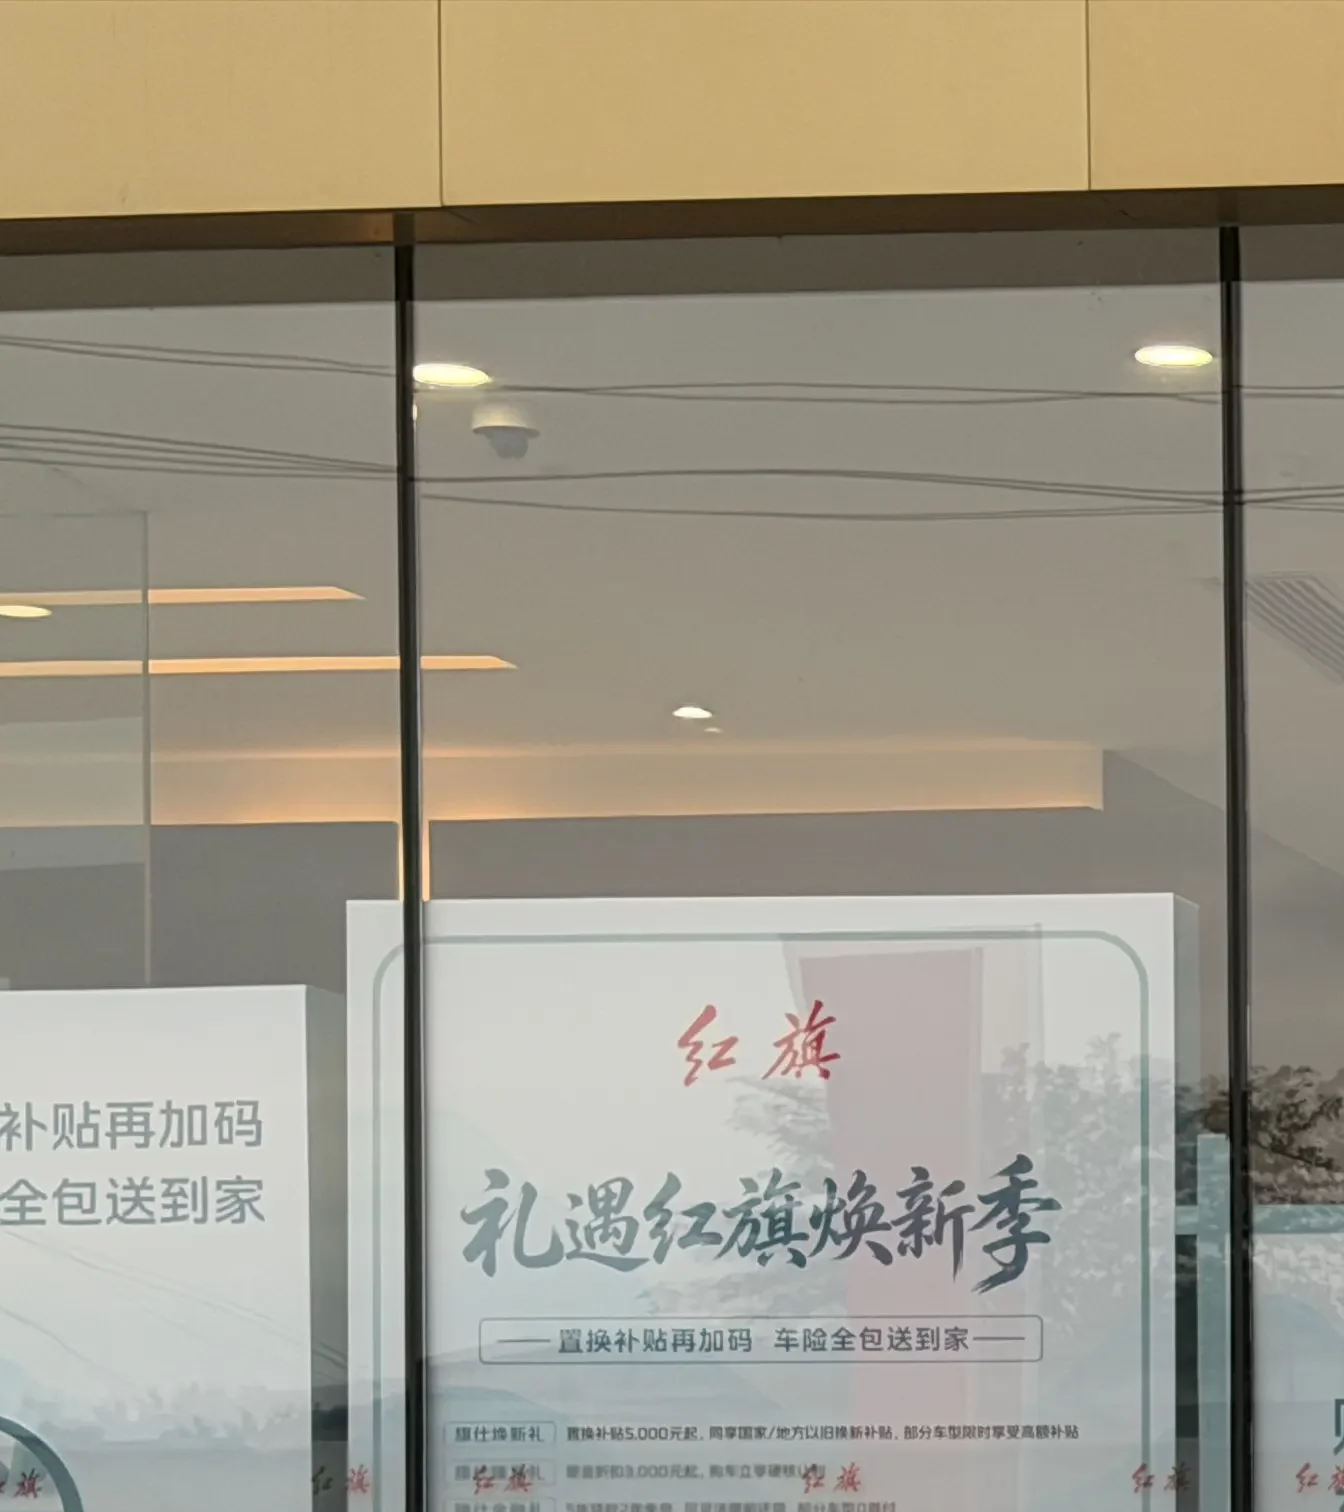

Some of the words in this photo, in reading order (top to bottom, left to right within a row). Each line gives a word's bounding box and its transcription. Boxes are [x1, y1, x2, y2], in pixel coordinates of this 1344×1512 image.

[677, 1000, 841, 1086] 红旗
[0, 1099, 264, 1151] 补贴再加码
[0, 1174, 266, 1226] 全包送到家
[460, 1154, 1062, 1295] 礼遇红旗焕新季
[558, 1327, 753, 1353] 置换补贴再加码
[774, 1325, 970, 1353] 车险全包送到家
